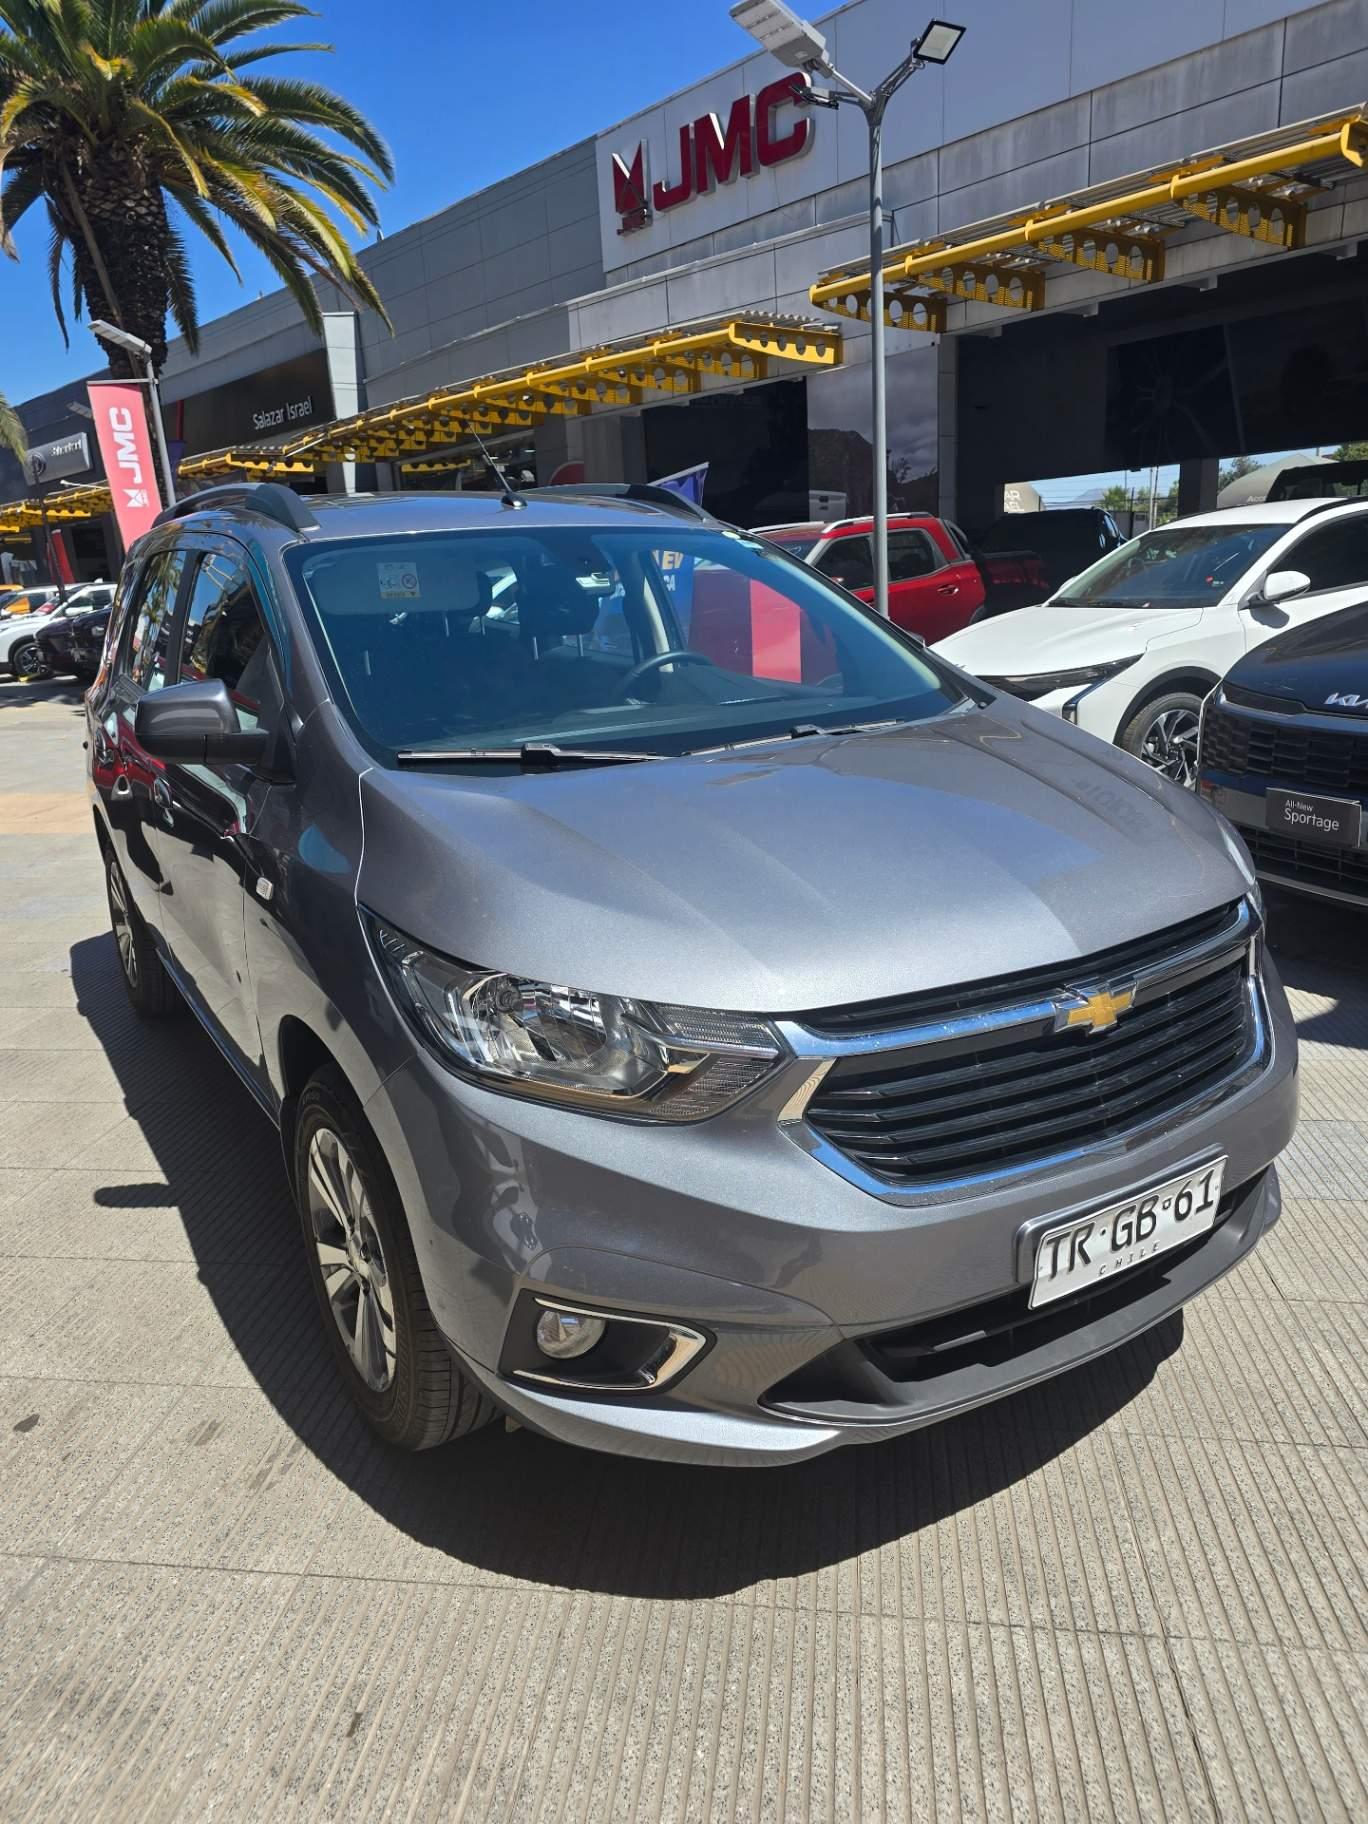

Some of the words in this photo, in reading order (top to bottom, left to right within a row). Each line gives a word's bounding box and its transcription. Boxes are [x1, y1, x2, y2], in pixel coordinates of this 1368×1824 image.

[653, 72, 814, 212] JMC
[253, 410, 285, 430] Salazar
[286, 395, 313, 420] Israel
[109, 407, 143, 484] JMC
[1284, 808, 1340, 832] Sportage
[1285, 800, 1314, 812] All-New
[1098, 1240, 1161, 1276] CHILE
